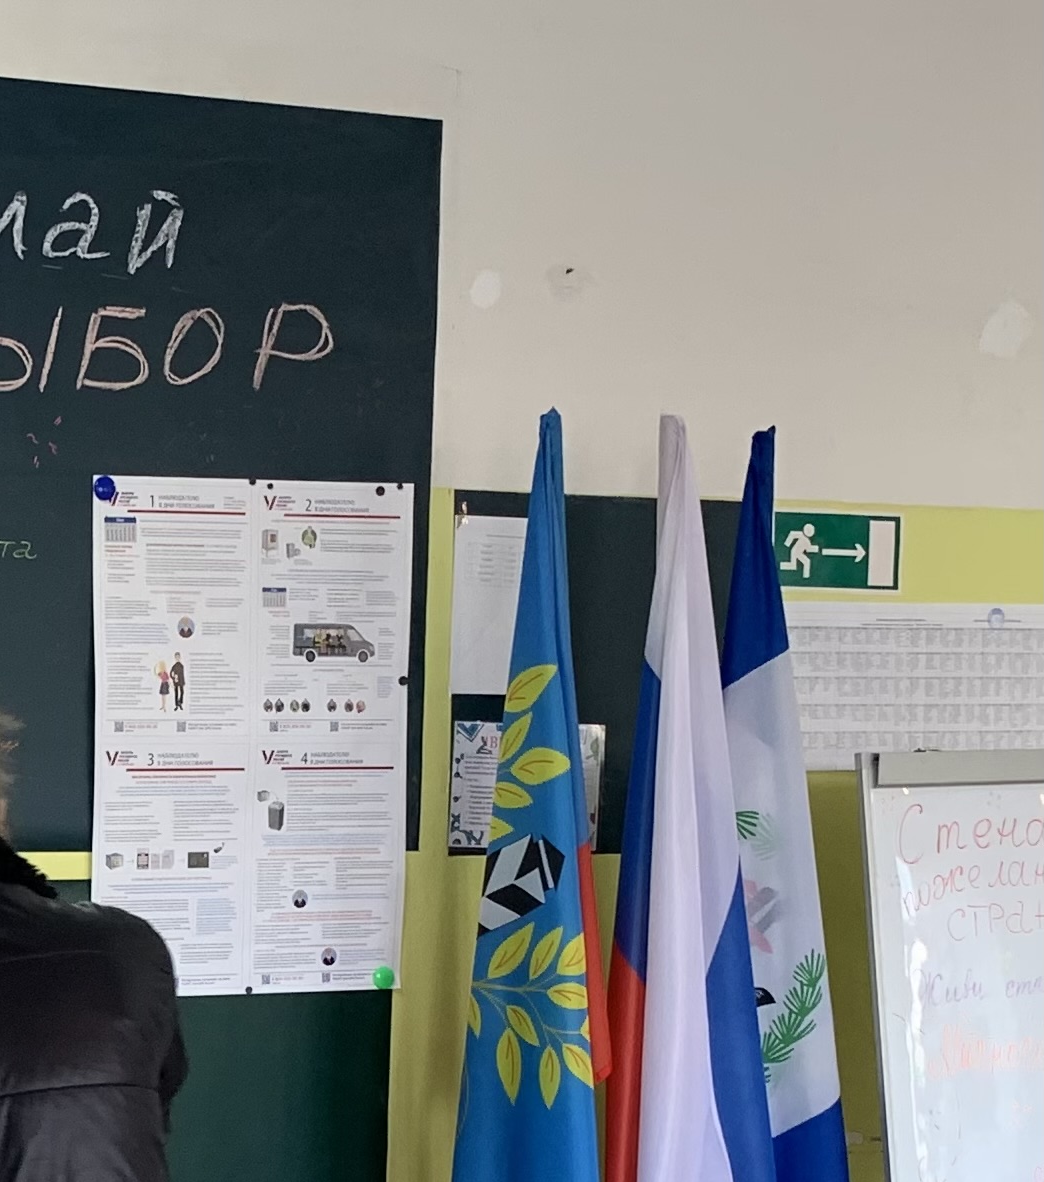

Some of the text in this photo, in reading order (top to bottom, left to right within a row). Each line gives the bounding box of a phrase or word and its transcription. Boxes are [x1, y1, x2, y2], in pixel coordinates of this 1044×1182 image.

[150, 495, 155, 507] 1
[305, 499, 312, 512] 2
[147, 753, 154, 766] 3
[301, 752, 308, 765] 4
